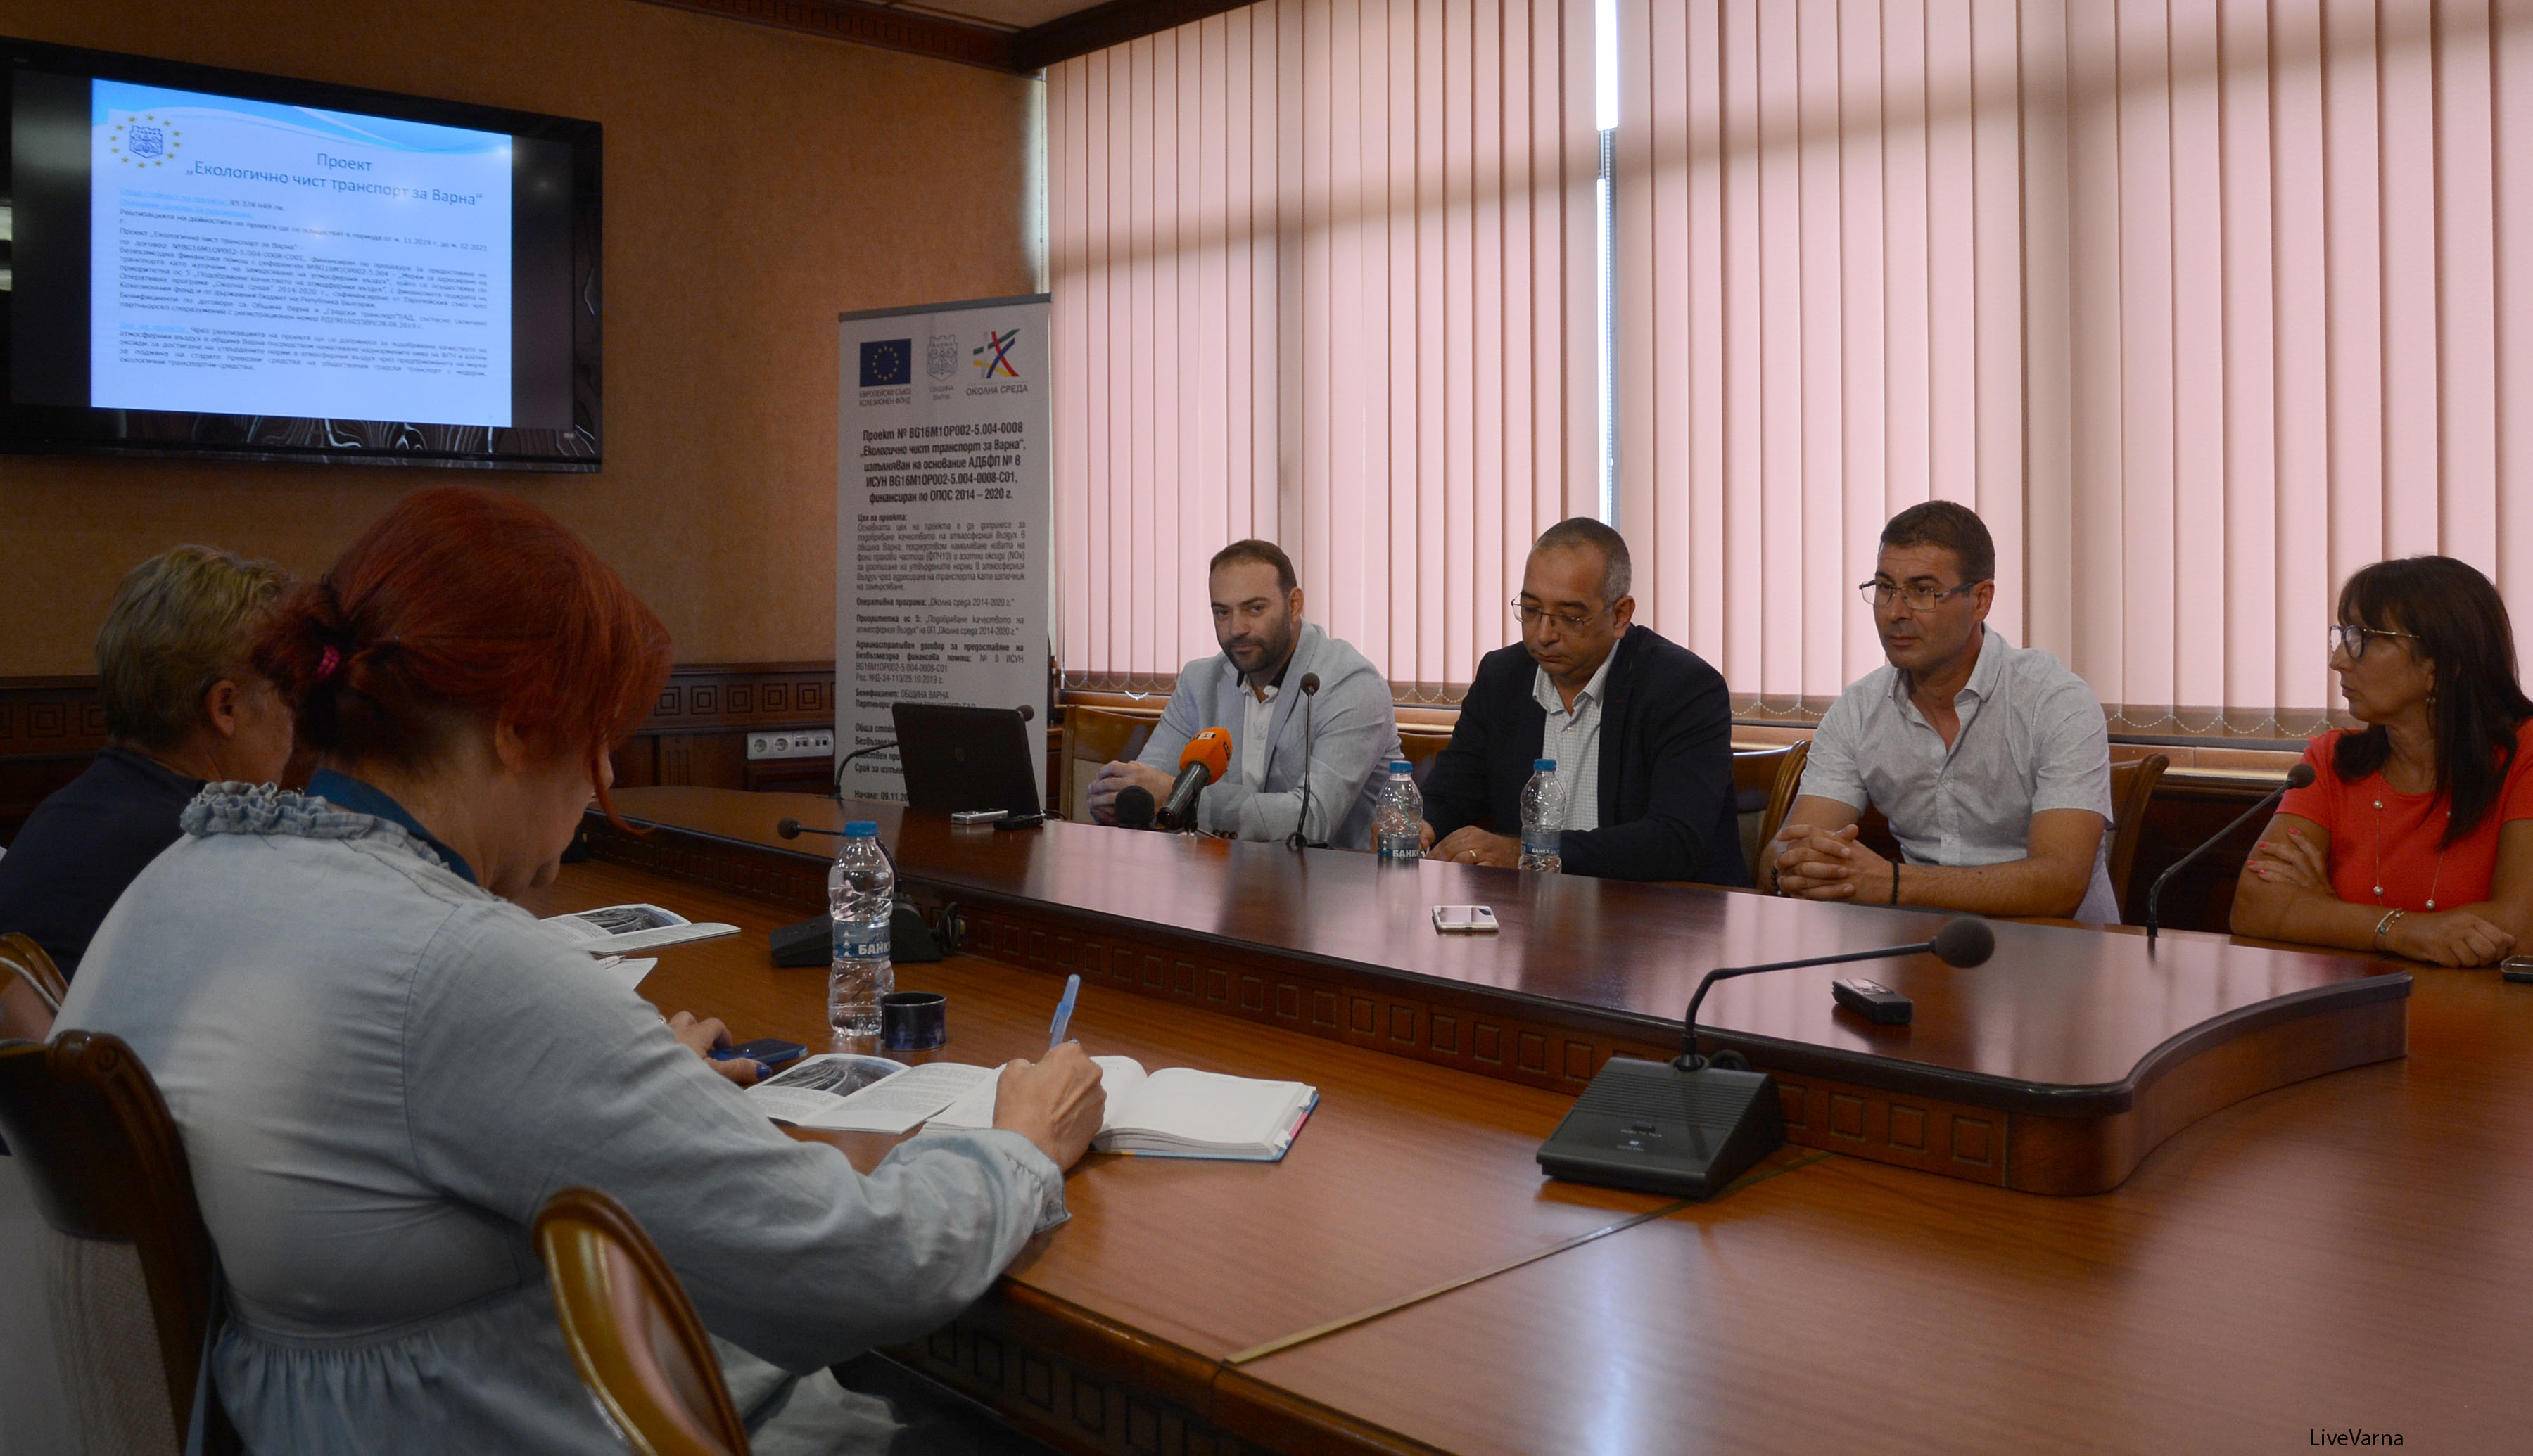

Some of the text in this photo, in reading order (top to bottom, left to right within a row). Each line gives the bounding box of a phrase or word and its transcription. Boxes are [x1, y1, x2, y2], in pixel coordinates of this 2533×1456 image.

[317, 153, 372, 174] Проект
[186, 159, 482, 207] „Екологично чист транспорт за Варна“
[965, 385, 998, 397] ОКОЛНА
[1000, 383, 1028, 395] СРЕДА
[863, 428, 894, 442] Проект
[897, 428, 907, 439] №
[908, 444, 929, 454] чист
[932, 441, 981, 455] транспорт
[982, 441, 992, 452] за
[863, 459, 910, 472] изпълняван
[912, 461, 921, 470] на
[923, 456, 966, 470] основание
[967, 454, 1000, 469] АДБФП
[1002, 454, 1012, 466] №
[865, 475, 887, 487] ИСУН
[869, 490, 917, 505] финансиран
[918, 492, 928, 502] по
[929, 489, 953, 502] ОПОС
[955, 488, 975, 500] 2014
[984, 487, 1004, 499] 2020
[1005, 490, 1012, 499] г.
[857, 513, 869, 523] Цел
[870, 514, 877, 523] на
